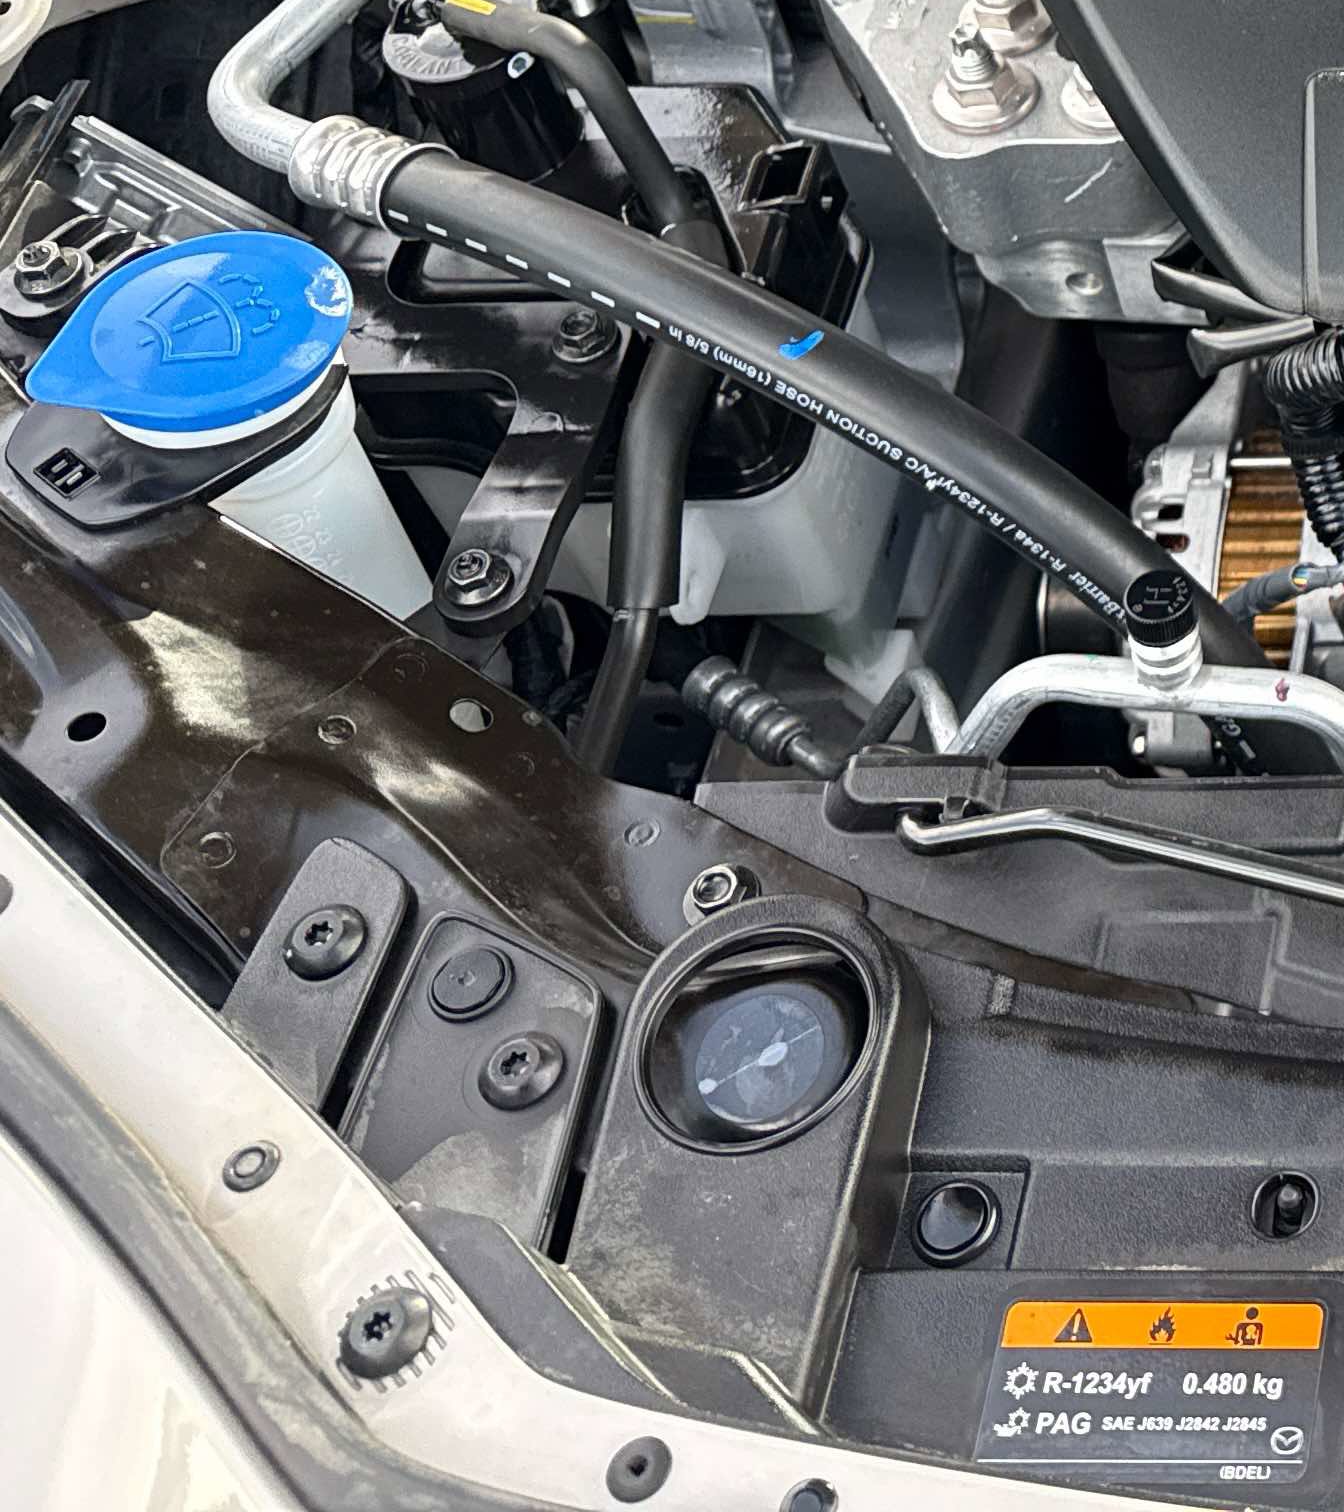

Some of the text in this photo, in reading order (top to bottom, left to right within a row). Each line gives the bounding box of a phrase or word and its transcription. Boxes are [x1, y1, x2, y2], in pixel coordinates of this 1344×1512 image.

[685, 333, 710, 355] 5/8
[712, 345, 772, 386] (16mm)
[773, 379, 824, 415] HOSE
[825, 408, 903, 461] SUCTION
[904, 456, 937, 480] A/C
[1013, 529, 1067, 572] R-134a
[1042, 1371, 1284, 1400] R-1234yf 0.480 kg
[1034, 1411, 1268, 1435] PAG SAE J639 J2842 J2845
[1219, 1465, 1272, 1481] (BDEL)
